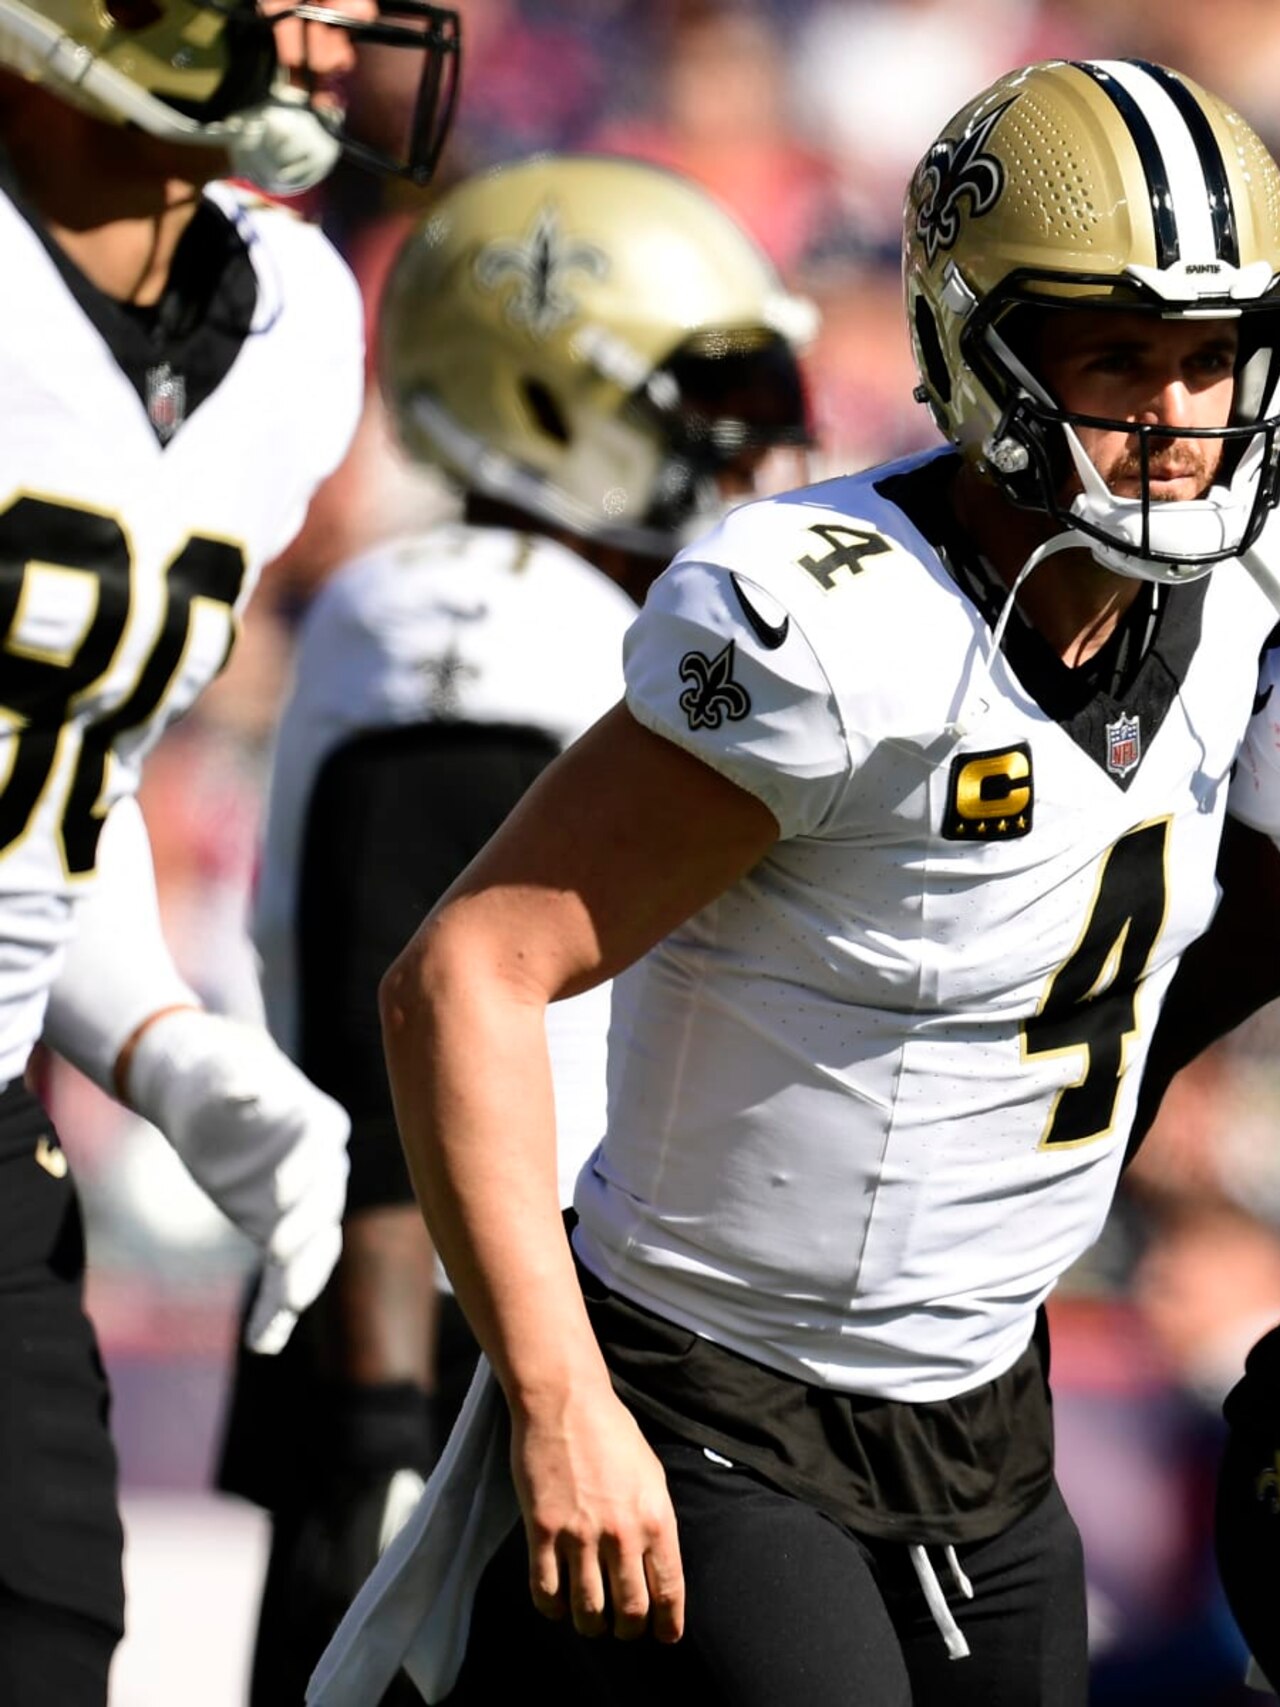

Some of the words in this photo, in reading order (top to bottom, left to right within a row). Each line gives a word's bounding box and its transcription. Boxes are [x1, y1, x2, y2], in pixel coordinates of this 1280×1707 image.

[796, 523, 893, 592] 4
[956, 750, 1030, 820] C
[1019, 811, 1174, 1152] 4
